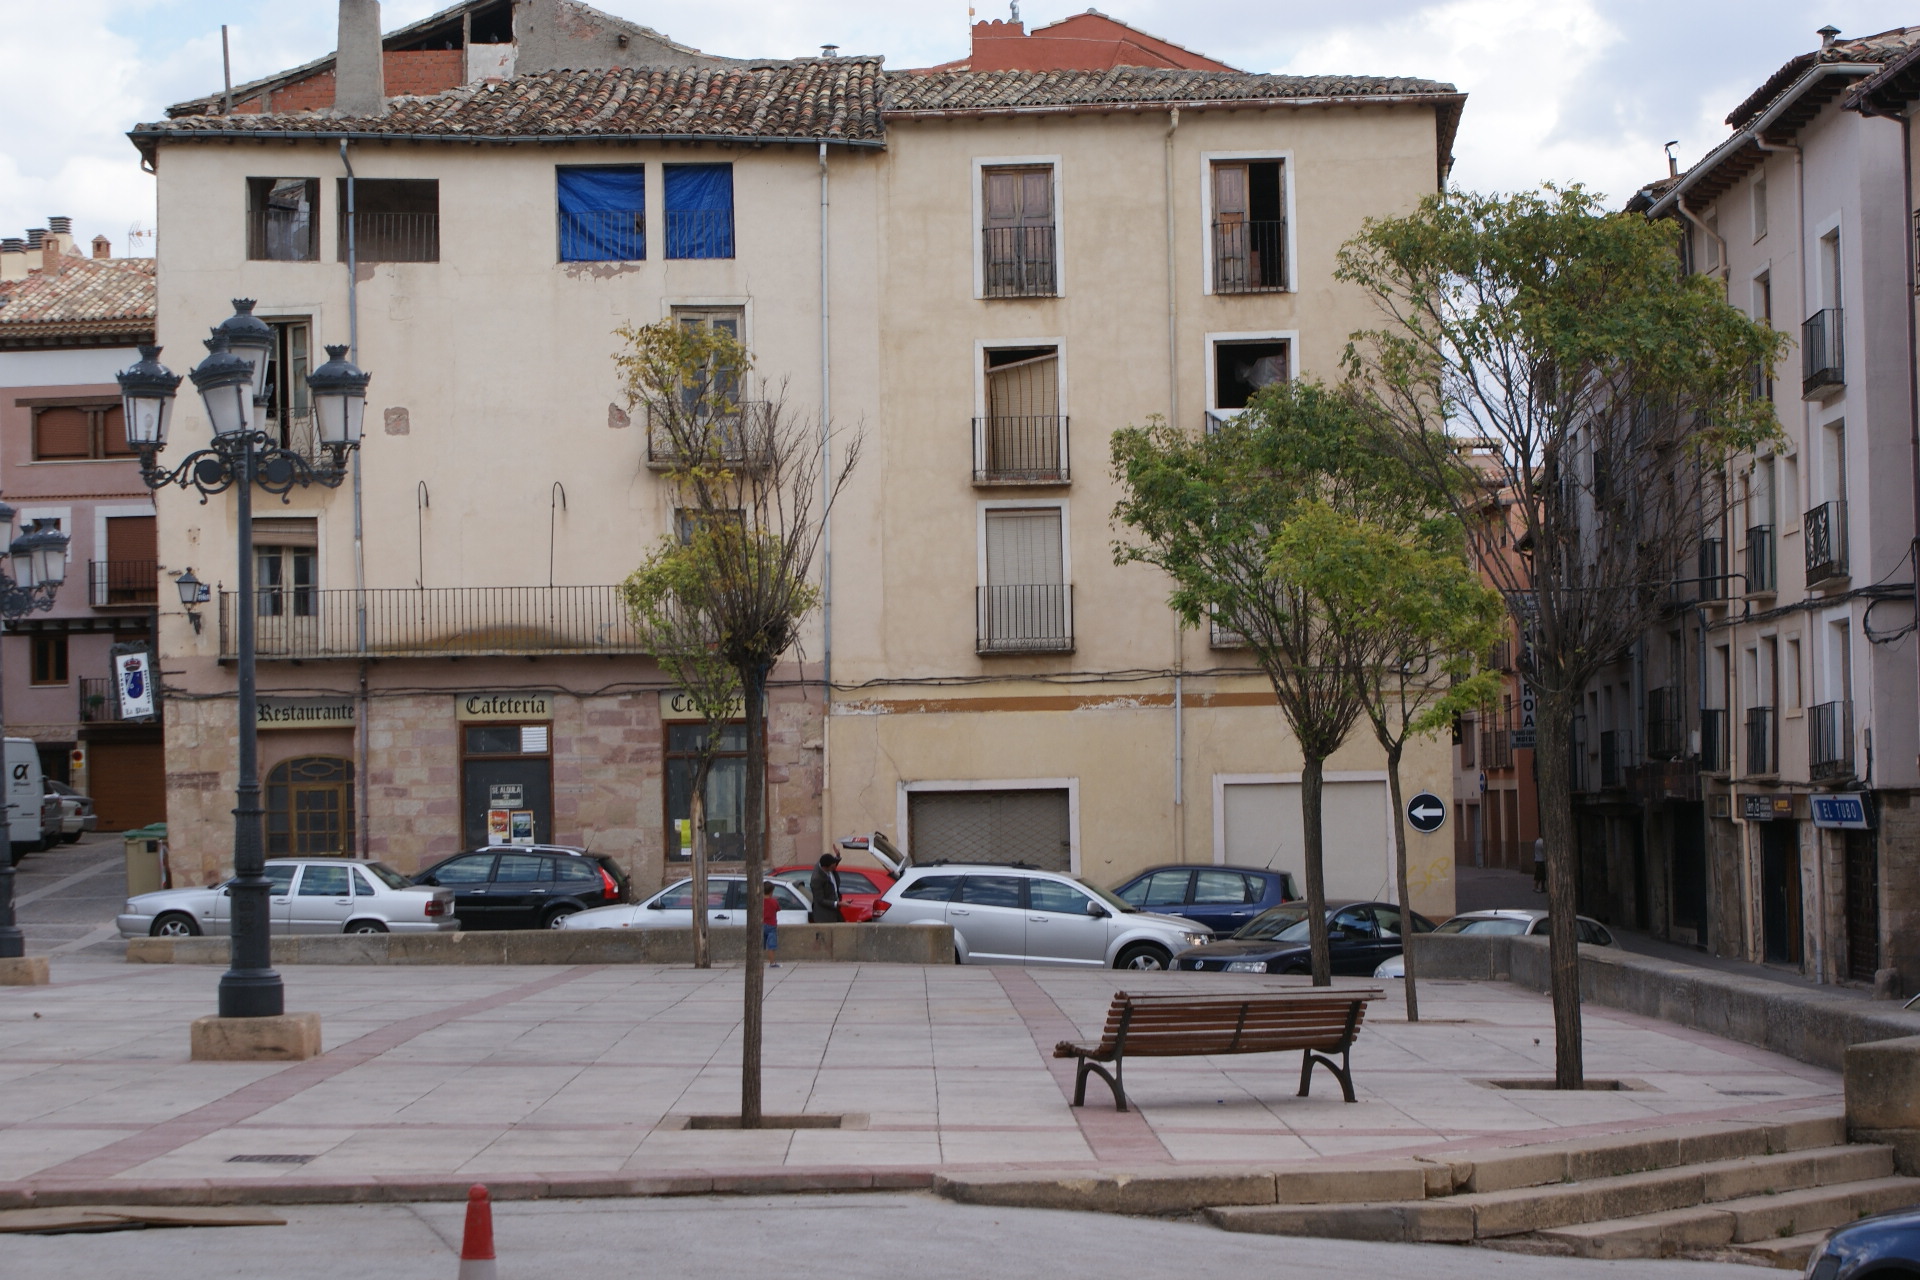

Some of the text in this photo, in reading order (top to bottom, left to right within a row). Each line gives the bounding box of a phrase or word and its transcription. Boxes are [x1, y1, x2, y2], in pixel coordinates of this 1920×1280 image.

[256, 703, 355, 722] Restaurante
[465, 693, 547, 716] Cafetería
[1523, 684, 1535, 728] ROA
[499, 786, 521, 794] ALQUILA
[1822, 803, 1857, 819] EL TUBO
